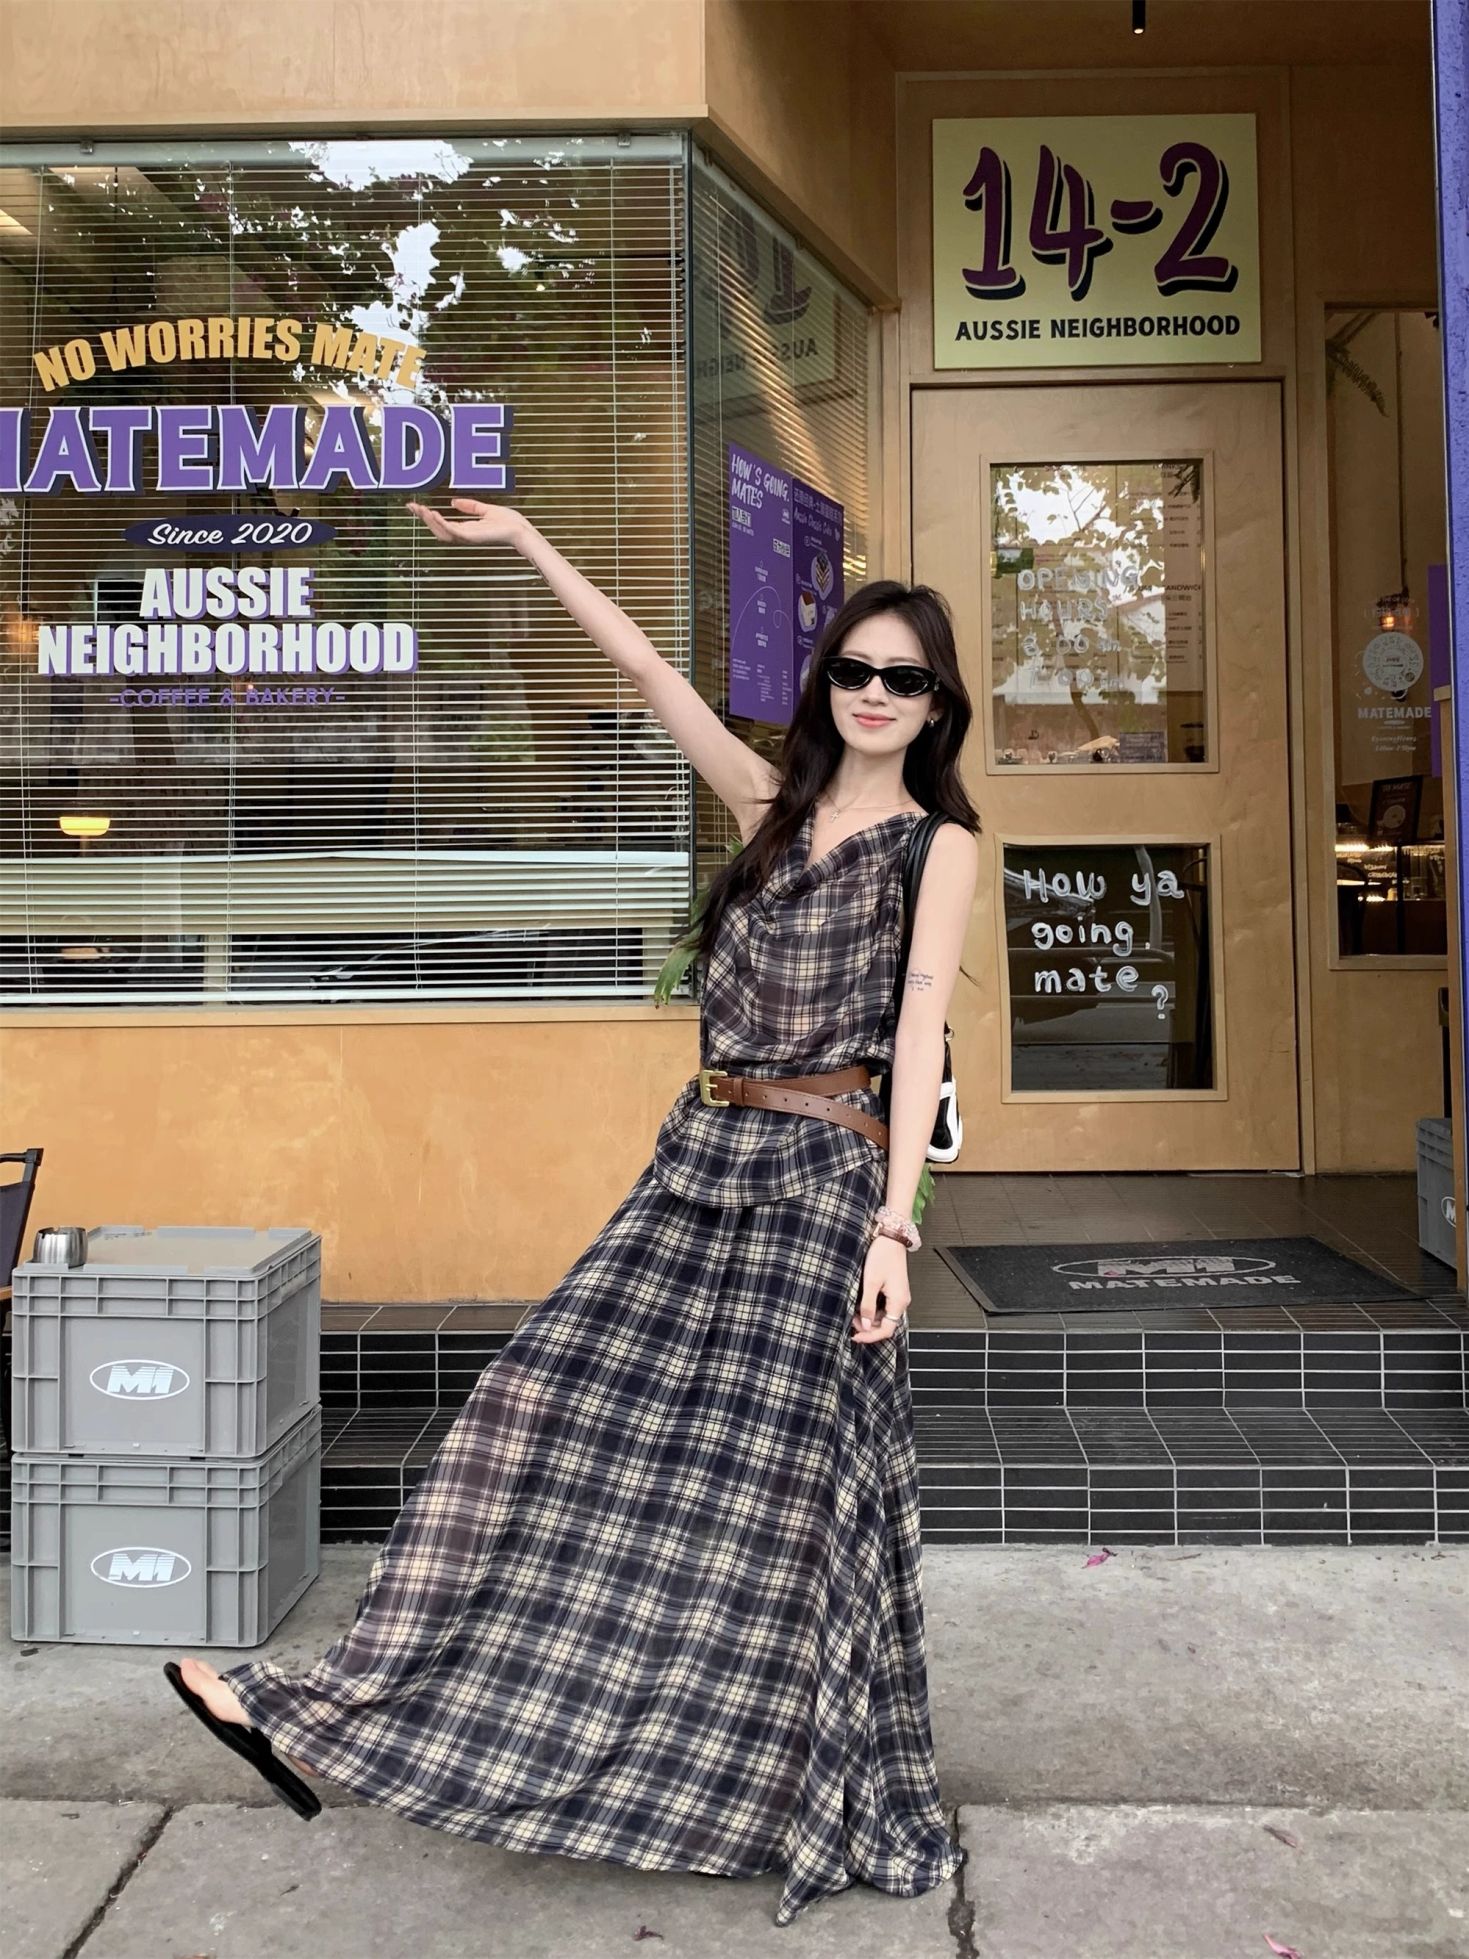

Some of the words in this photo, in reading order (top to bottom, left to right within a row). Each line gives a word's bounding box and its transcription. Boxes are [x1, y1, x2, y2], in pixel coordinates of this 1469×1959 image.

[962, 142, 1239, 301] 14-2
[955, 319, 1041, 341] AUSSIE
[1050, 314, 1240, 339] NEIGHBORHOOD
[33, 337, 96, 392] NO
[100, 316, 302, 373] WORRIES
[311, 323, 427, 390] MATE
[0, 404, 516, 495] ATEMADE
[731, 453, 763, 486] HOW'S
[147, 522, 224, 546] Since
[231, 522, 314, 545] 2020
[139, 566, 316, 620] AUSSIE
[1019, 599, 1108, 622] HOURS
[37, 622, 420, 677] NEIGHBORHOOD
[220, 688, 235, 707] &
[1357, 706, 1433, 720] MATEMADE
[1023, 867, 1107, 903] How
[1130, 870, 1185, 906] ya
[1068, 1274, 1302, 1291] MATEMADE
